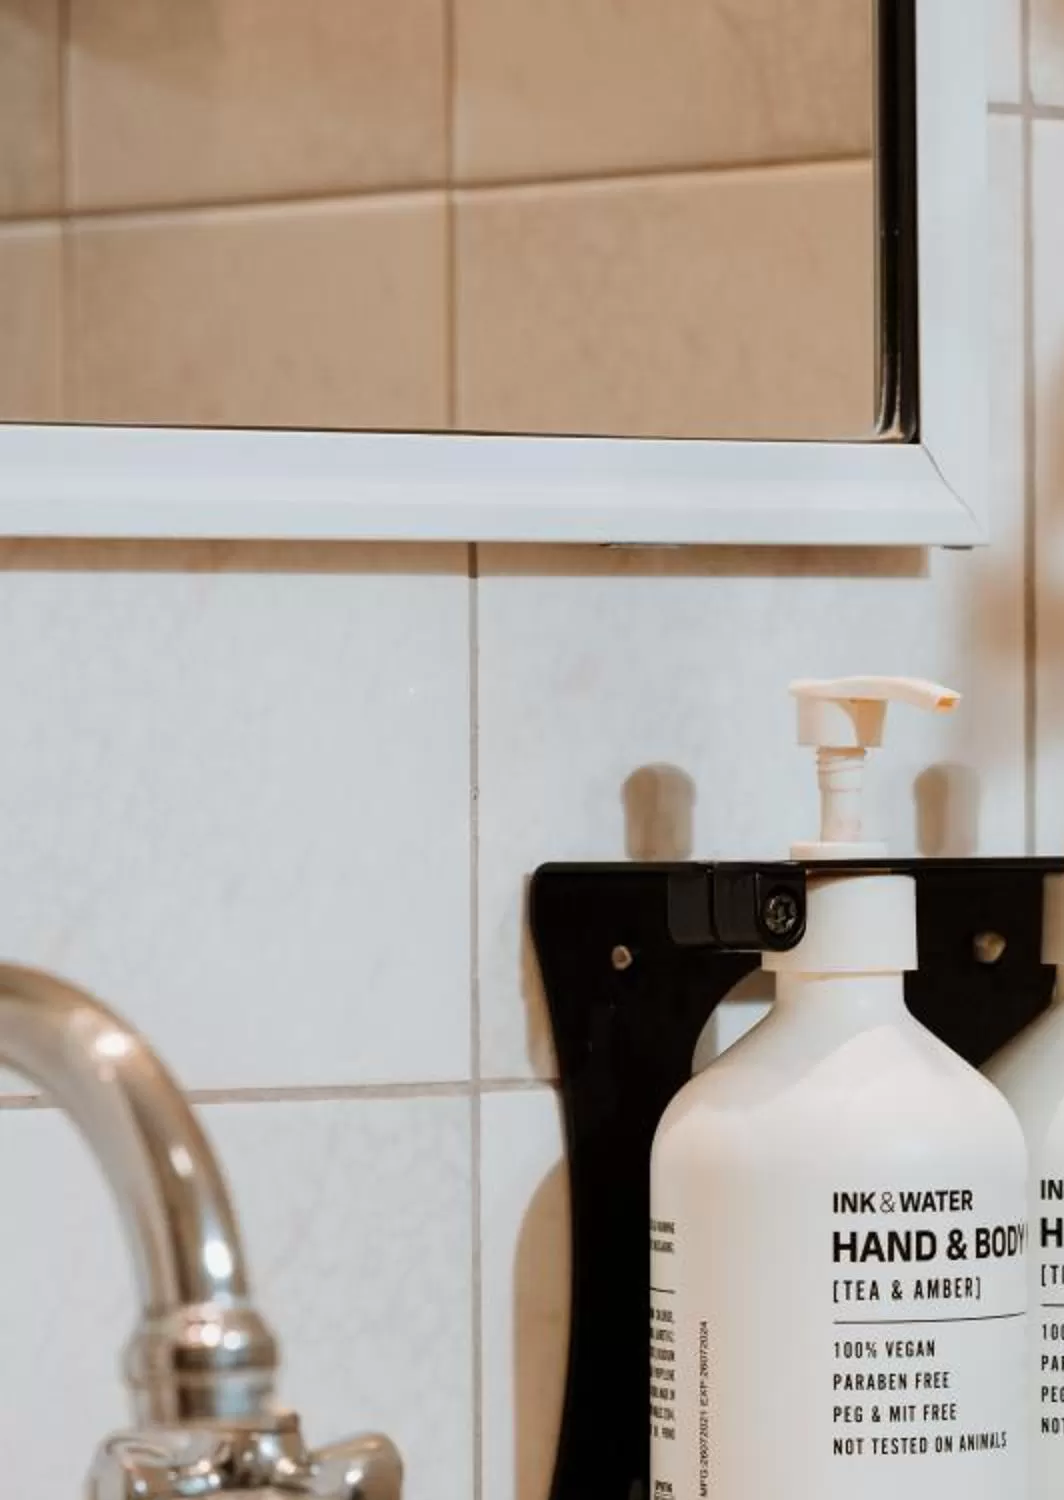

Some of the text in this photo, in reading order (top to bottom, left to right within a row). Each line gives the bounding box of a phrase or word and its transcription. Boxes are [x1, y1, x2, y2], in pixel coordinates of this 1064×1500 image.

[833, 1230, 937, 1263] HAND
[946, 1228, 968, 1260] &
[975, 1224, 1024, 1259] BODY
[833, 1276, 980, 1303] [TEA & AMBER]
[834, 1340, 935, 1359] 100% VEGAN
[833, 1372, 949, 1390] PARABEN FREE
[833, 1403, 956, 1423] PEG & MIT FREE
[834, 1432, 1006, 1455] NOT TESTED ON ANIMALS
